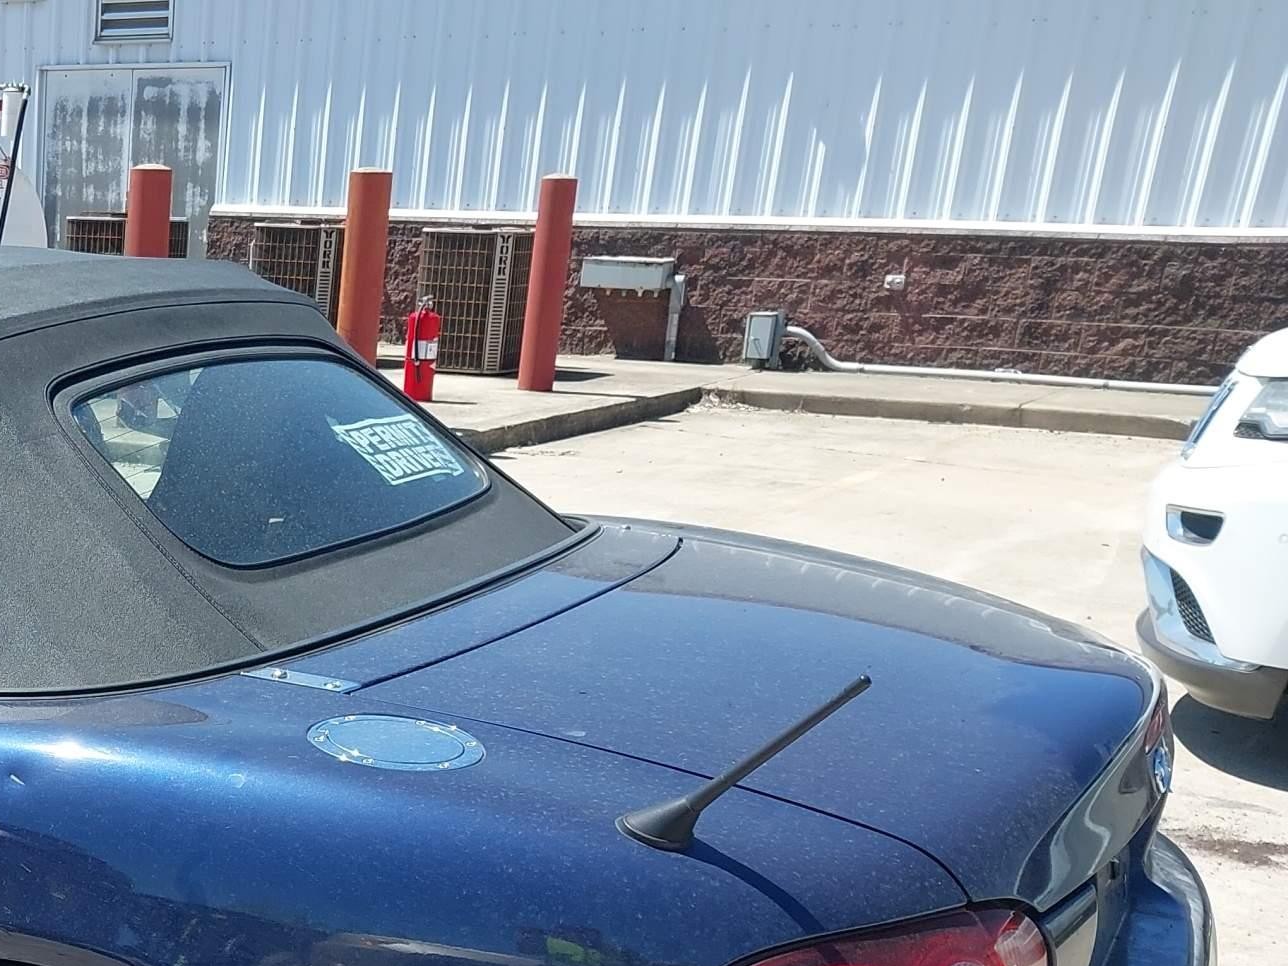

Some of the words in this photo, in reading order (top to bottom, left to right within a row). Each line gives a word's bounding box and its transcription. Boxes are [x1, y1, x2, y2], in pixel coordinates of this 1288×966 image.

[322, 229, 336, 270] YORK
[498, 235, 513, 276] YORK
[347, 421, 430, 454] PERMIT
[373, 444, 449, 478] DRIVER
